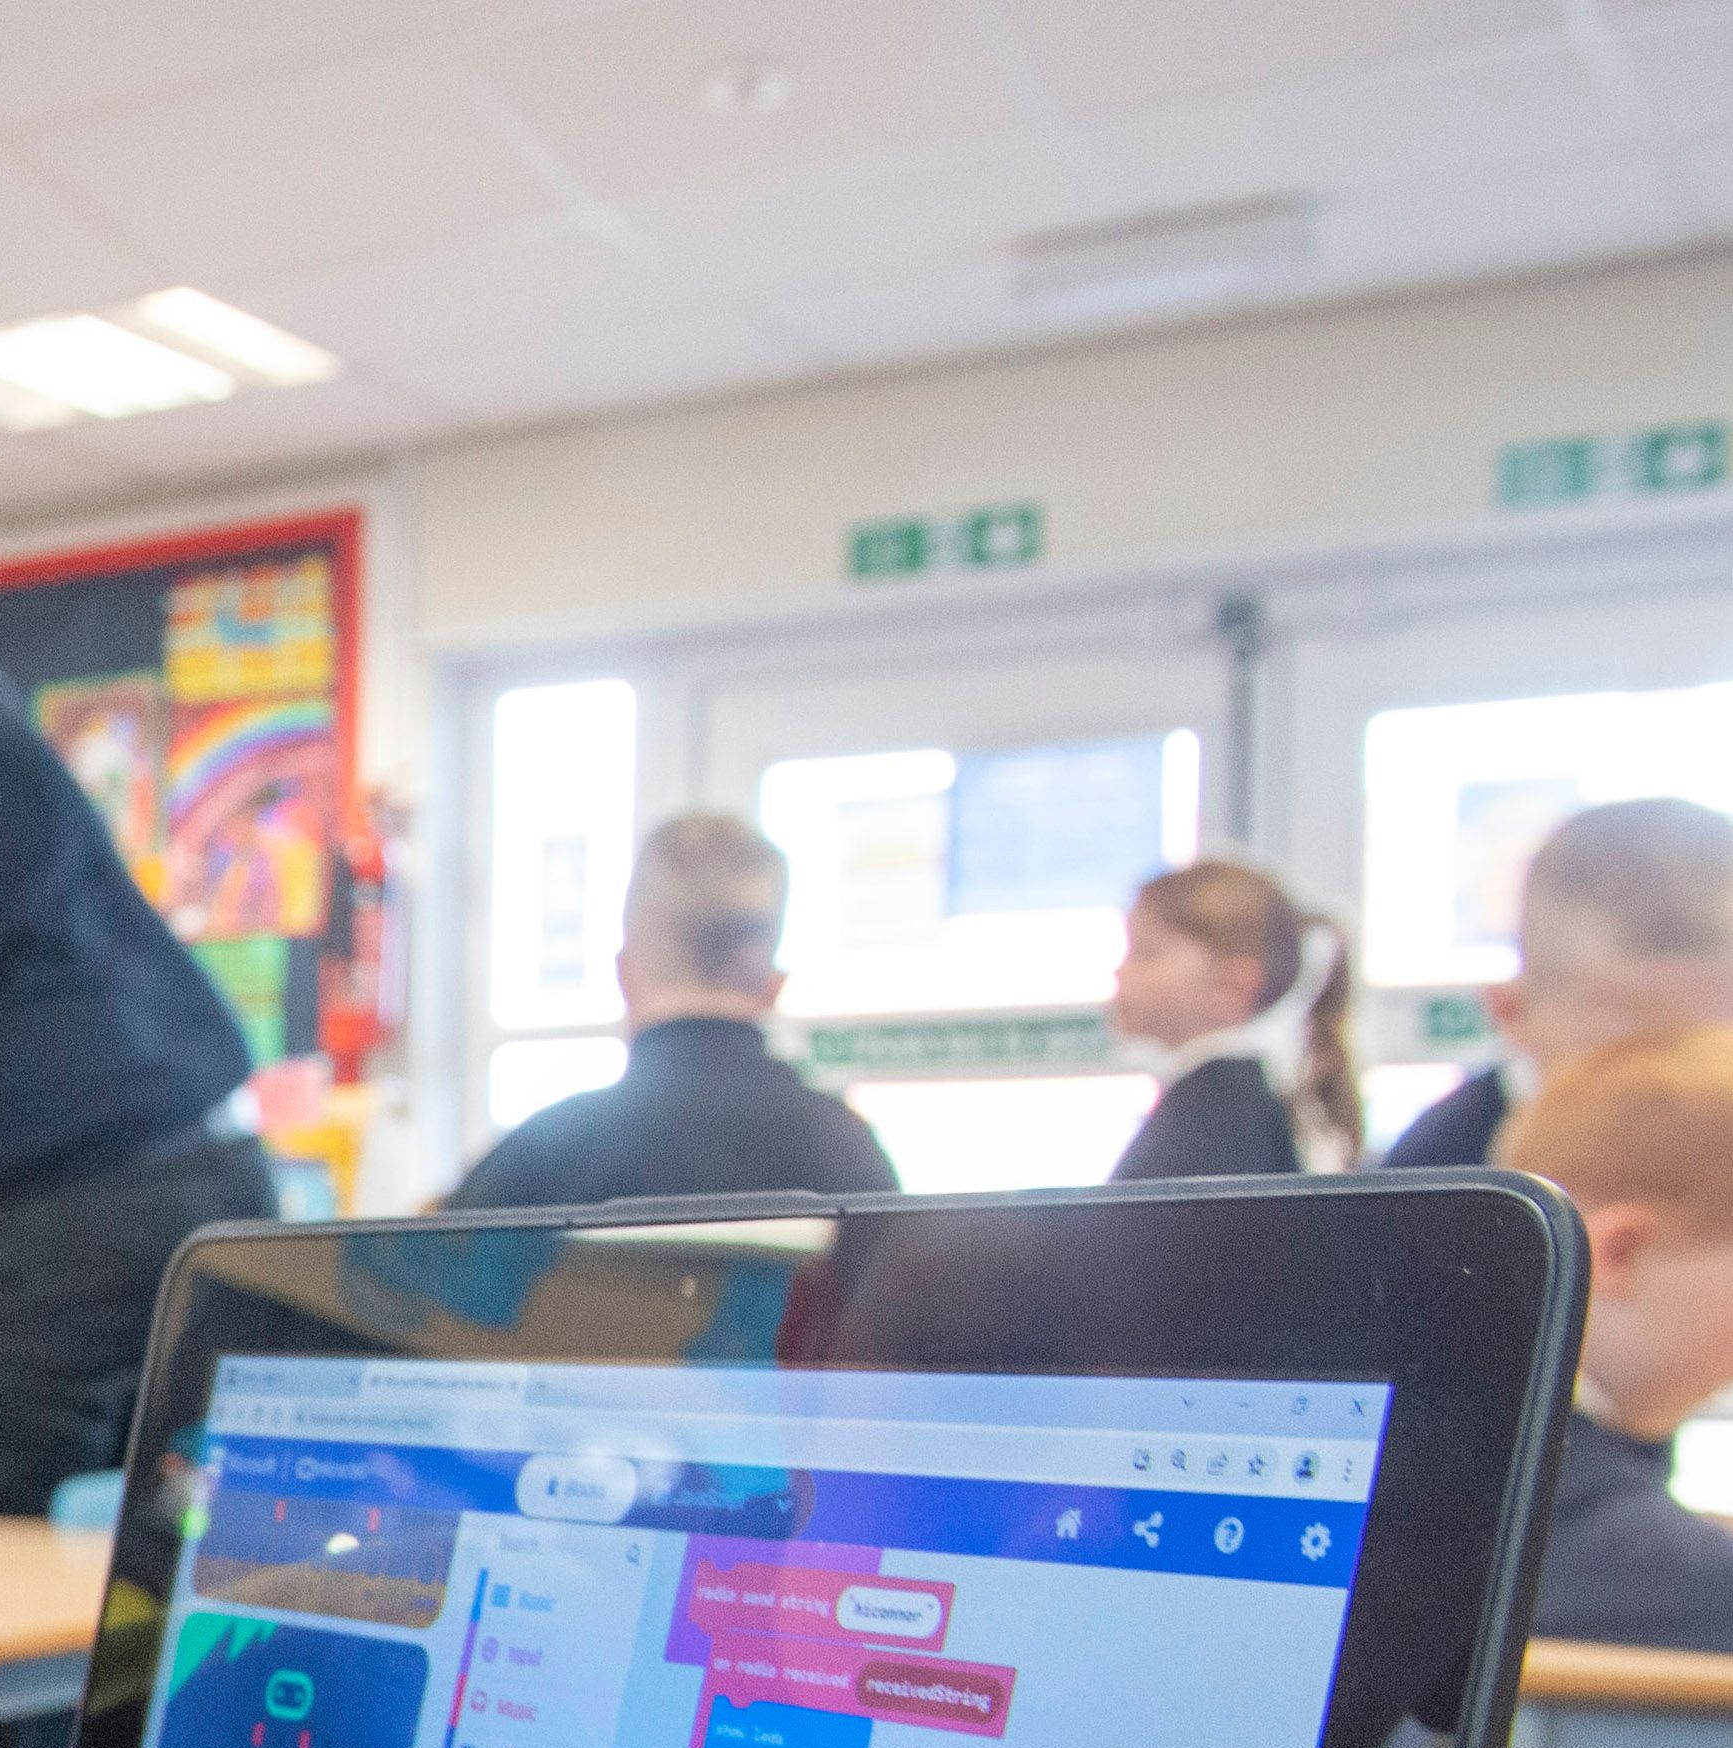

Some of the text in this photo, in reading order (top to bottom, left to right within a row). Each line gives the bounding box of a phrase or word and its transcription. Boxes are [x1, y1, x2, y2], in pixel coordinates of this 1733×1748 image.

[696, 1586, 737, 1603] radio
[741, 1590, 776, 1607] send
[780, 1595, 831, 1619] string
[736, 1659, 778, 1679] radio
[783, 1666, 853, 1690] received
[865, 1676, 994, 1714] receivedString
